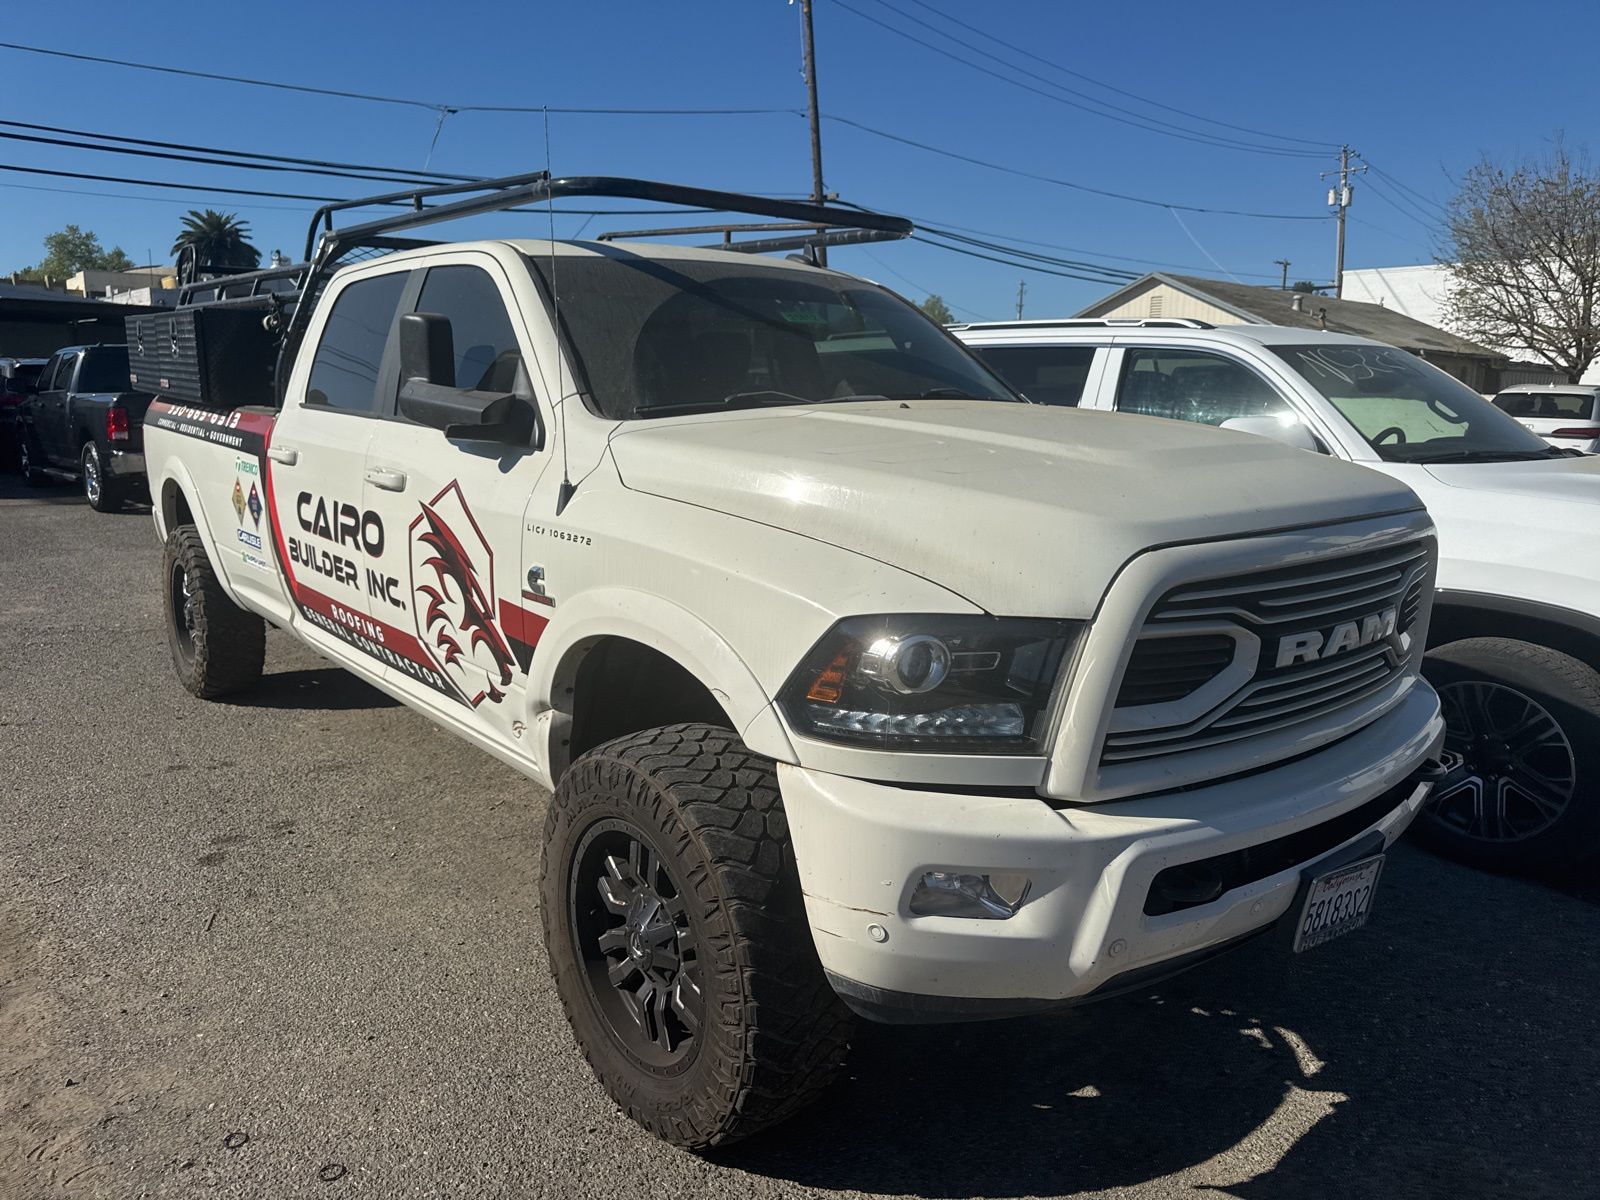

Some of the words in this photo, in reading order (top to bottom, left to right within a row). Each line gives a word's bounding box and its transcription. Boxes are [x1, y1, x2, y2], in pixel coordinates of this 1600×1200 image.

[179, 423, 206, 438] RESIDENTIAL
[209, 431, 243, 448] GOVERNMENT
[296, 491, 385, 559] CAIRO
[549, 529, 592, 546] 1063272
[288, 536, 361, 592] BUILDER
[365, 567, 407, 612] INC.
[303, 605, 352, 642] GENERAL
[353, 631, 446, 690] CONTRACTOR
[330, 603, 386, 643] ROOFING
[1275, 606, 1397, 669] RAM
